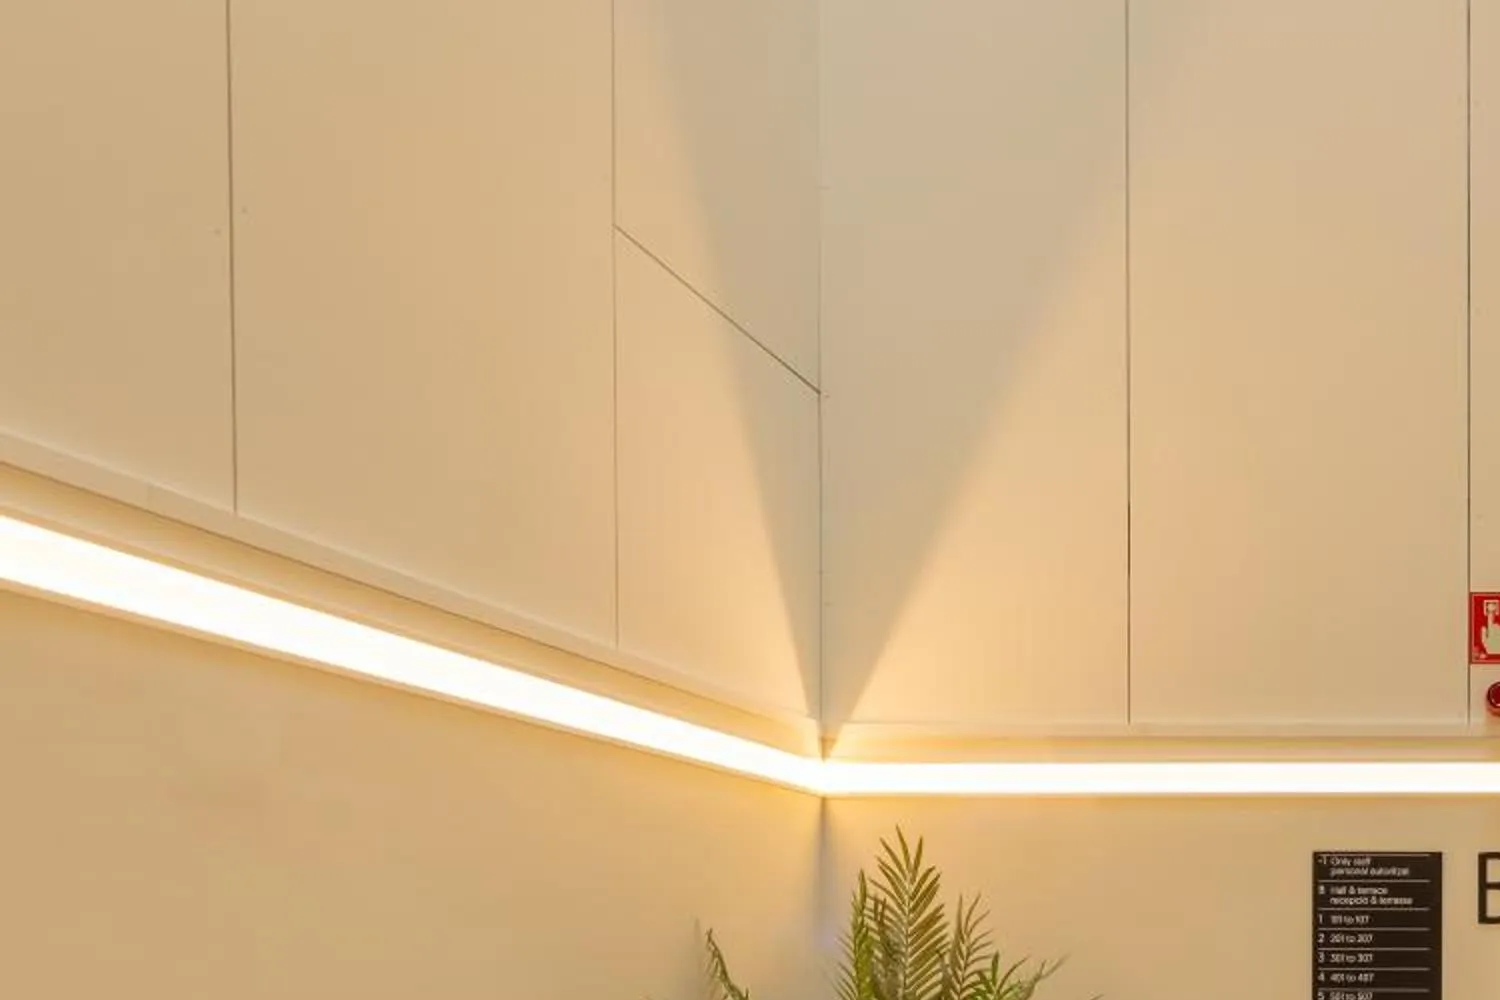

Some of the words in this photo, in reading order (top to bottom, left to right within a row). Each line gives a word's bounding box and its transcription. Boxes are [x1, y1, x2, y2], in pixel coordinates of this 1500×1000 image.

[1330, 856, 1351, 867] Only
[1318, 933, 1325, 943] 2
[1318, 952, 1325, 963] 3
[1318, 973, 1325, 983] 4
[1318, 991, 1325, 1000] 5
